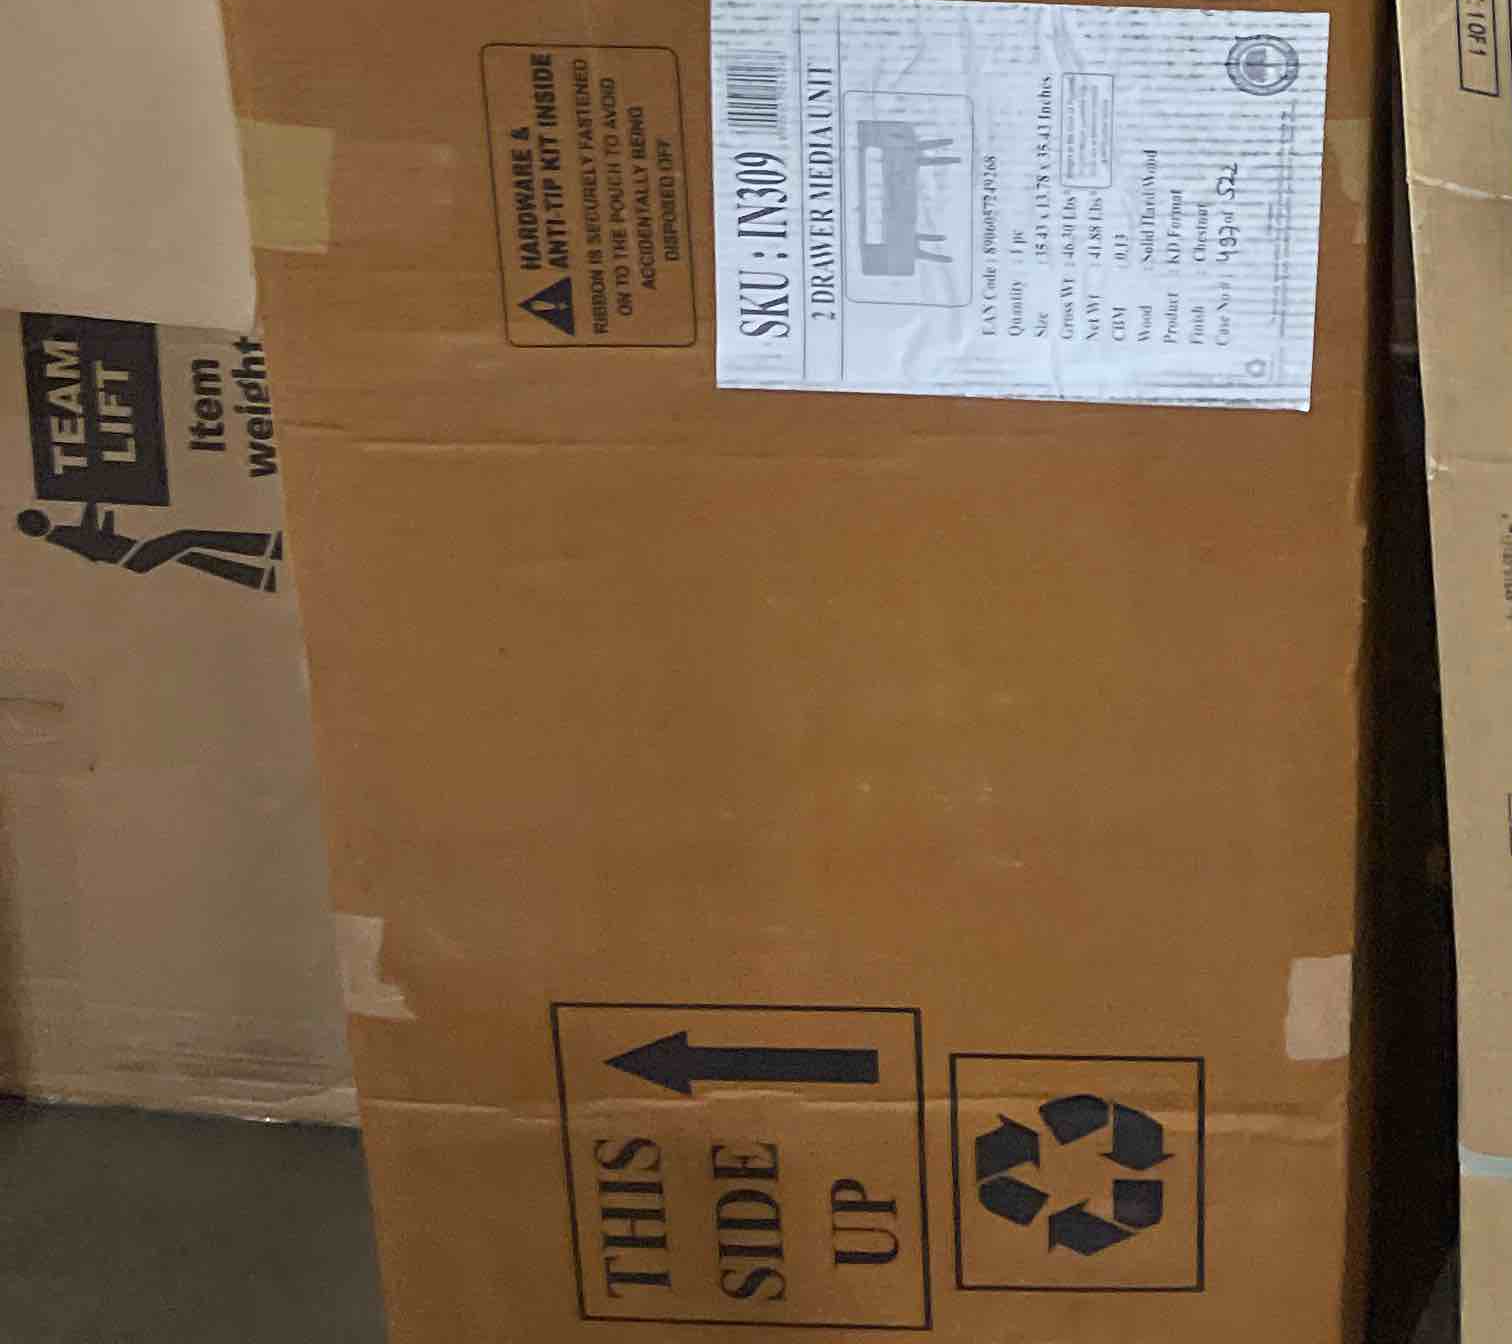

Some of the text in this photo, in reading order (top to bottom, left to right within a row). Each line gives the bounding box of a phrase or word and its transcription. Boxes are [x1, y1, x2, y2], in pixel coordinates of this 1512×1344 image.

[1468, 23, 1486, 45] OF
[599, 77, 617, 130] AVOID
[530, 53, 569, 270] ANTI-TIP KIT INSIDE
[604, 134, 620, 158] TO
[1143, 148, 1158, 190] Wood
[509, 127, 541, 271] HARDWARE &
[572, 58, 609, 335] RIBBON IS SECURELY FASTENED
[606, 162, 625, 223] POUCH
[627, 106, 658, 290] ACCIDENTALLY BEING
[659, 175, 680, 262] DISPOSED
[731, 152, 788, 239] IN309
[806, 62, 836, 321] 2 DRAWER MEDIA UNIT
[1168, 189, 1183, 239] Format
[611, 228, 629, 260] THE
[1140, 229, 1156, 266] Solid
[1193, 201, 1209, 263] Chestnut
[615, 265, 631, 287] TO
[738, 268, 789, 339] SKU
[1009, 279, 1024, 338] Quantity
[1138, 305, 1153, 343] Wood
[1163, 292, 1179, 345] Product
[41, 338, 88, 477] TEAM
[94, 359, 137, 464] LIFT
[189, 358, 226, 452] Item
[592, 1136, 673, 1299] THIS
[711, 1140, 787, 1302] SIDE
[829, 1177, 899, 1267] UP
